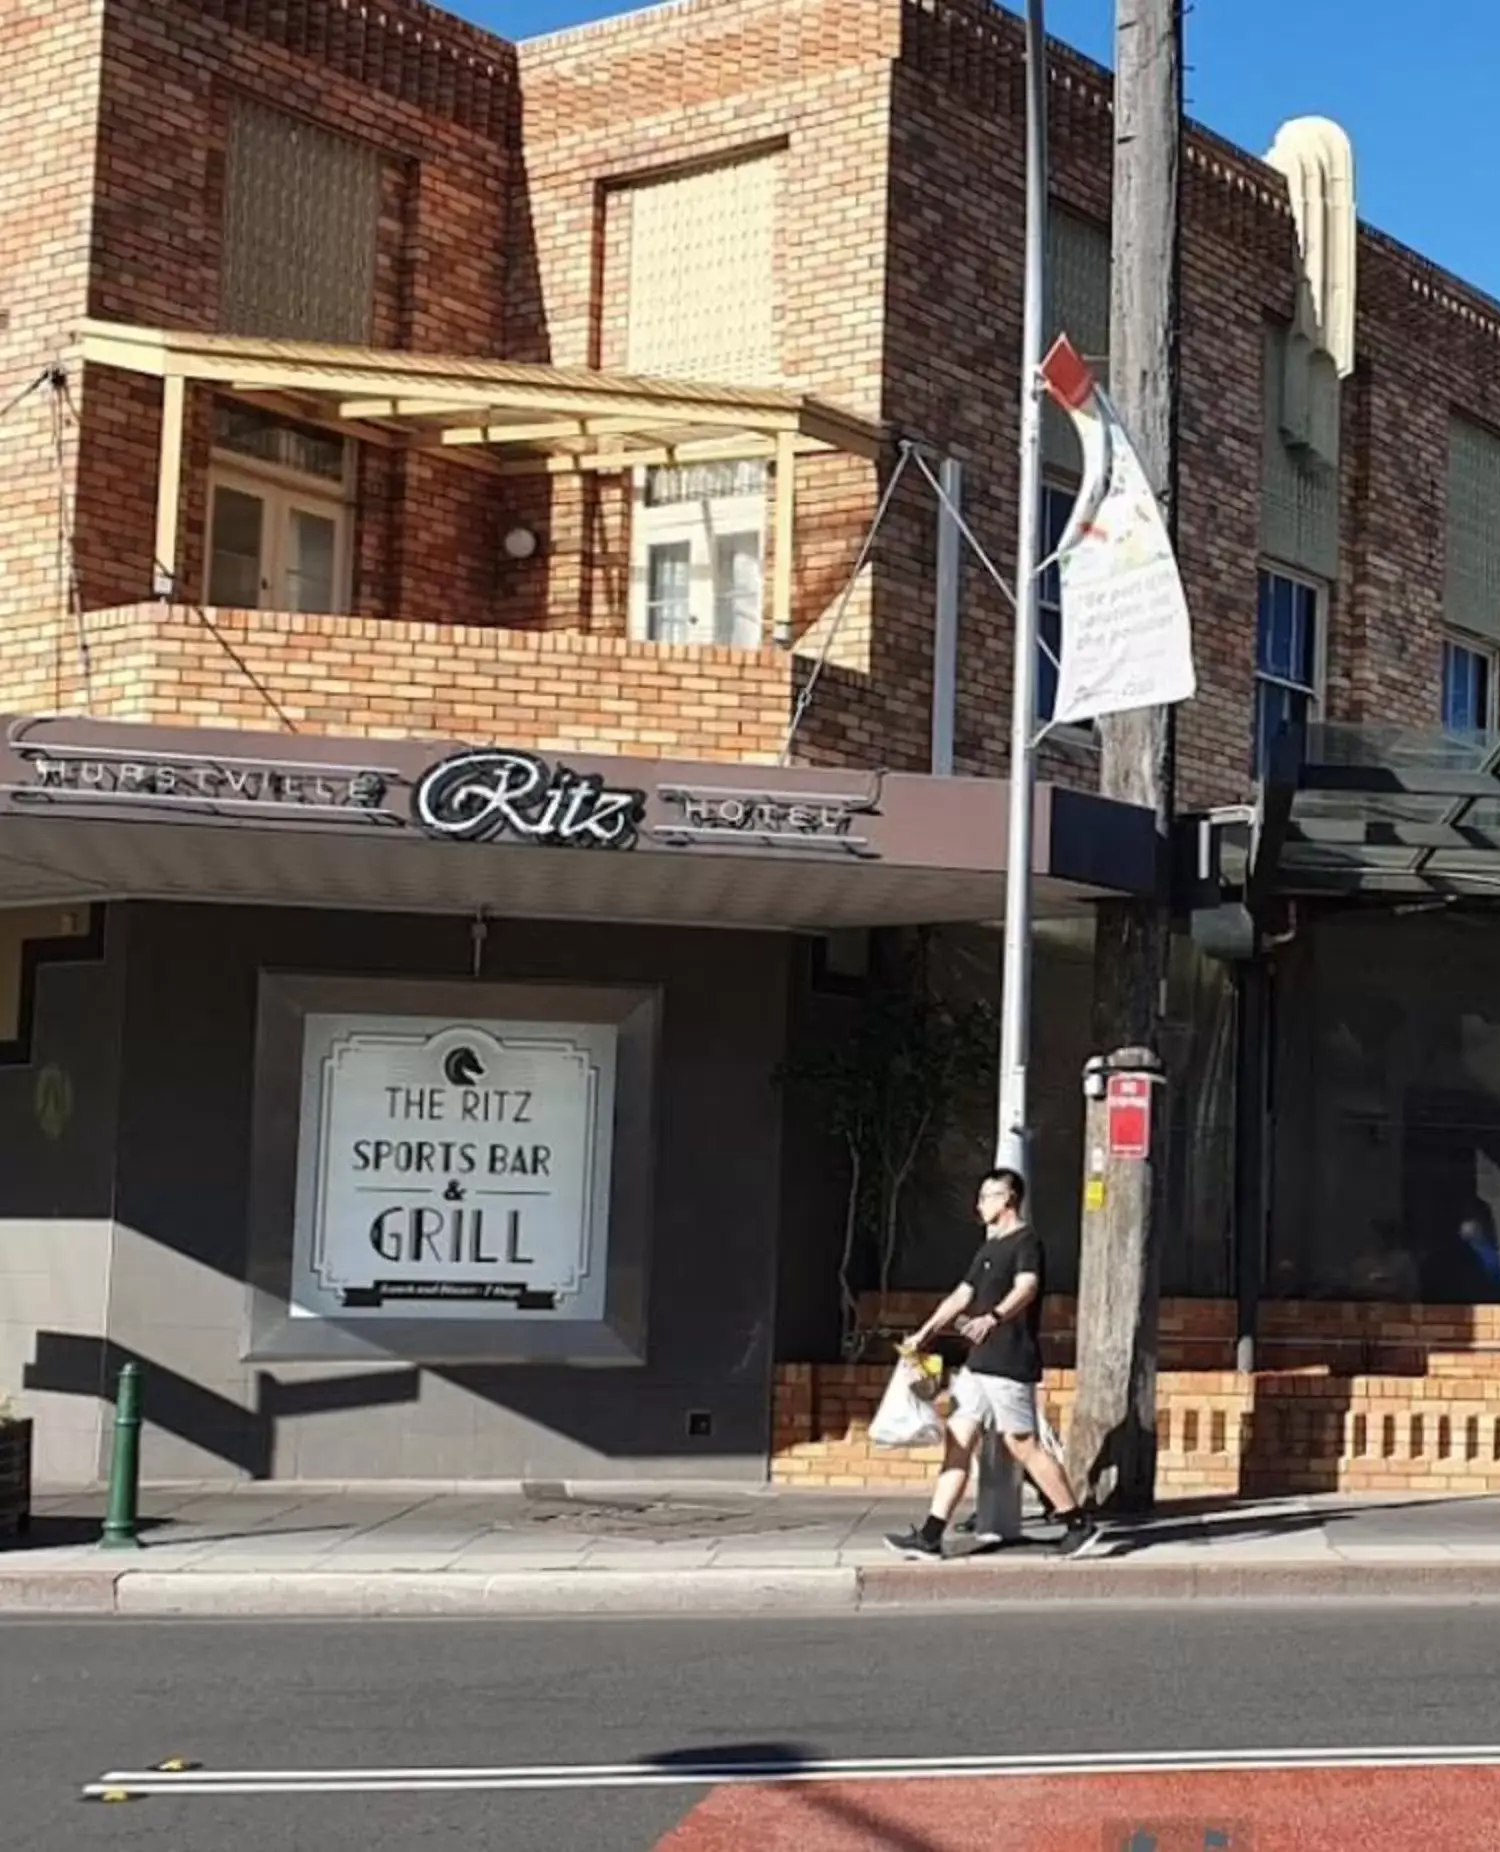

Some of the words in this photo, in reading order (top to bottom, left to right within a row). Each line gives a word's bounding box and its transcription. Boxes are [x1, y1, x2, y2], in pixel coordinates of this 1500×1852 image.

[35, 758, 373, 800] HURSTVILLE
[418, 751, 635, 840] Ritz
[684, 798, 844, 830] HOTEL
[385, 1086, 446, 1121] THE
[461, 1089, 534, 1123] RITZ
[352, 1139, 477, 1174] SPORTS
[488, 1143, 552, 1177] BAR
[443, 1178, 467, 1202] &
[369, 1206, 535, 1264] GRILL
